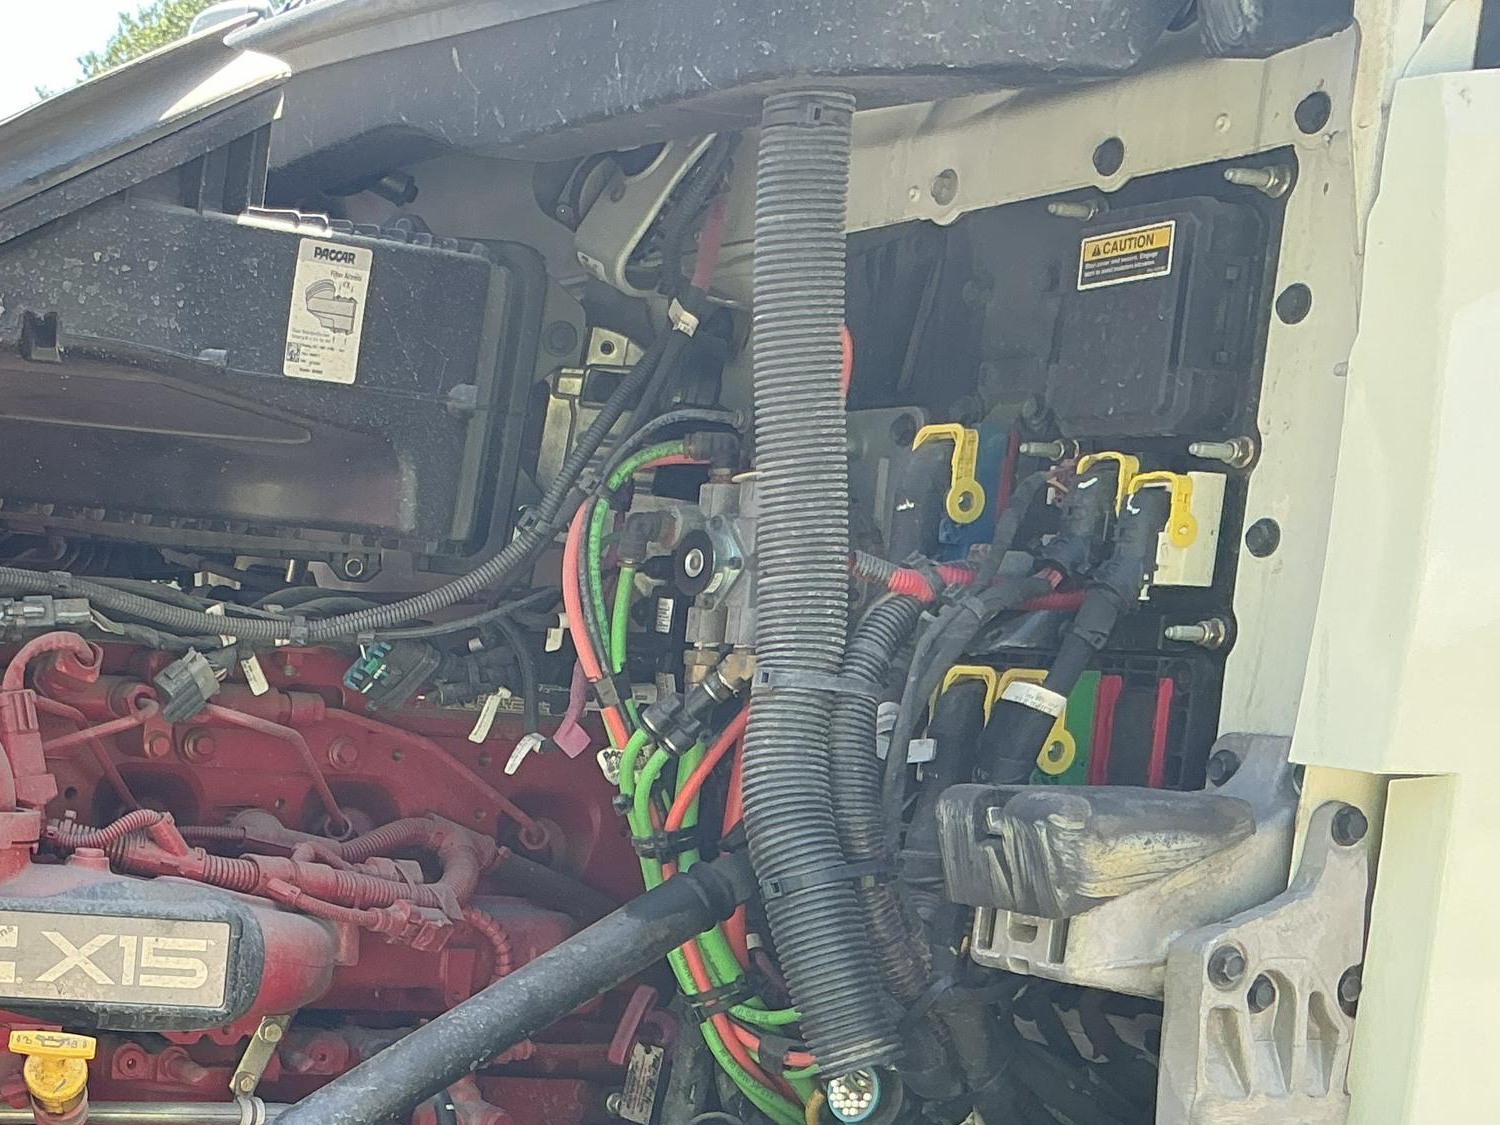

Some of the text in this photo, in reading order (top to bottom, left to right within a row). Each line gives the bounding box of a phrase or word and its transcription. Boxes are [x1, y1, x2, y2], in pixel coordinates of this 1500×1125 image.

[1102, 233, 1155, 255] CAUTION
[313, 246, 356, 265] PACCAR
[35, 930, 209, 990] X15
